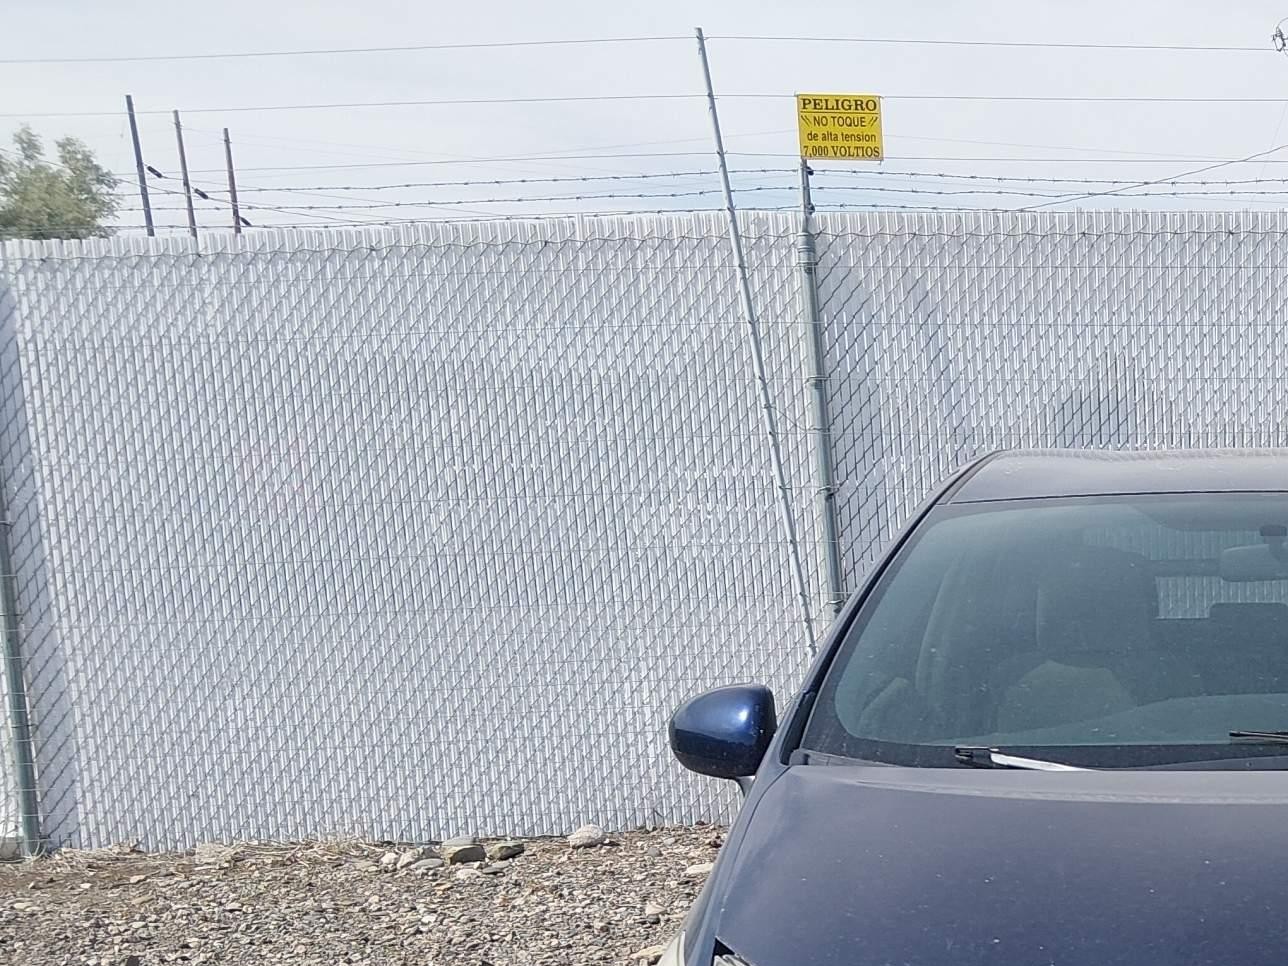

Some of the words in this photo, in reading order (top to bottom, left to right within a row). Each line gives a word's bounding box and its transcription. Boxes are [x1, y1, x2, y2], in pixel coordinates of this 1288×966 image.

[801, 98, 877, 111] PELIGRO
[813, 116, 828, 127] NO
[830, 116, 867, 127] TOQUE
[807, 131, 819, 141] de
[821, 131, 839, 142] alta
[841, 132, 877, 142] tension
[803, 146, 829, 158] 7,000
[831, 146, 880, 157] VOLTIOS
